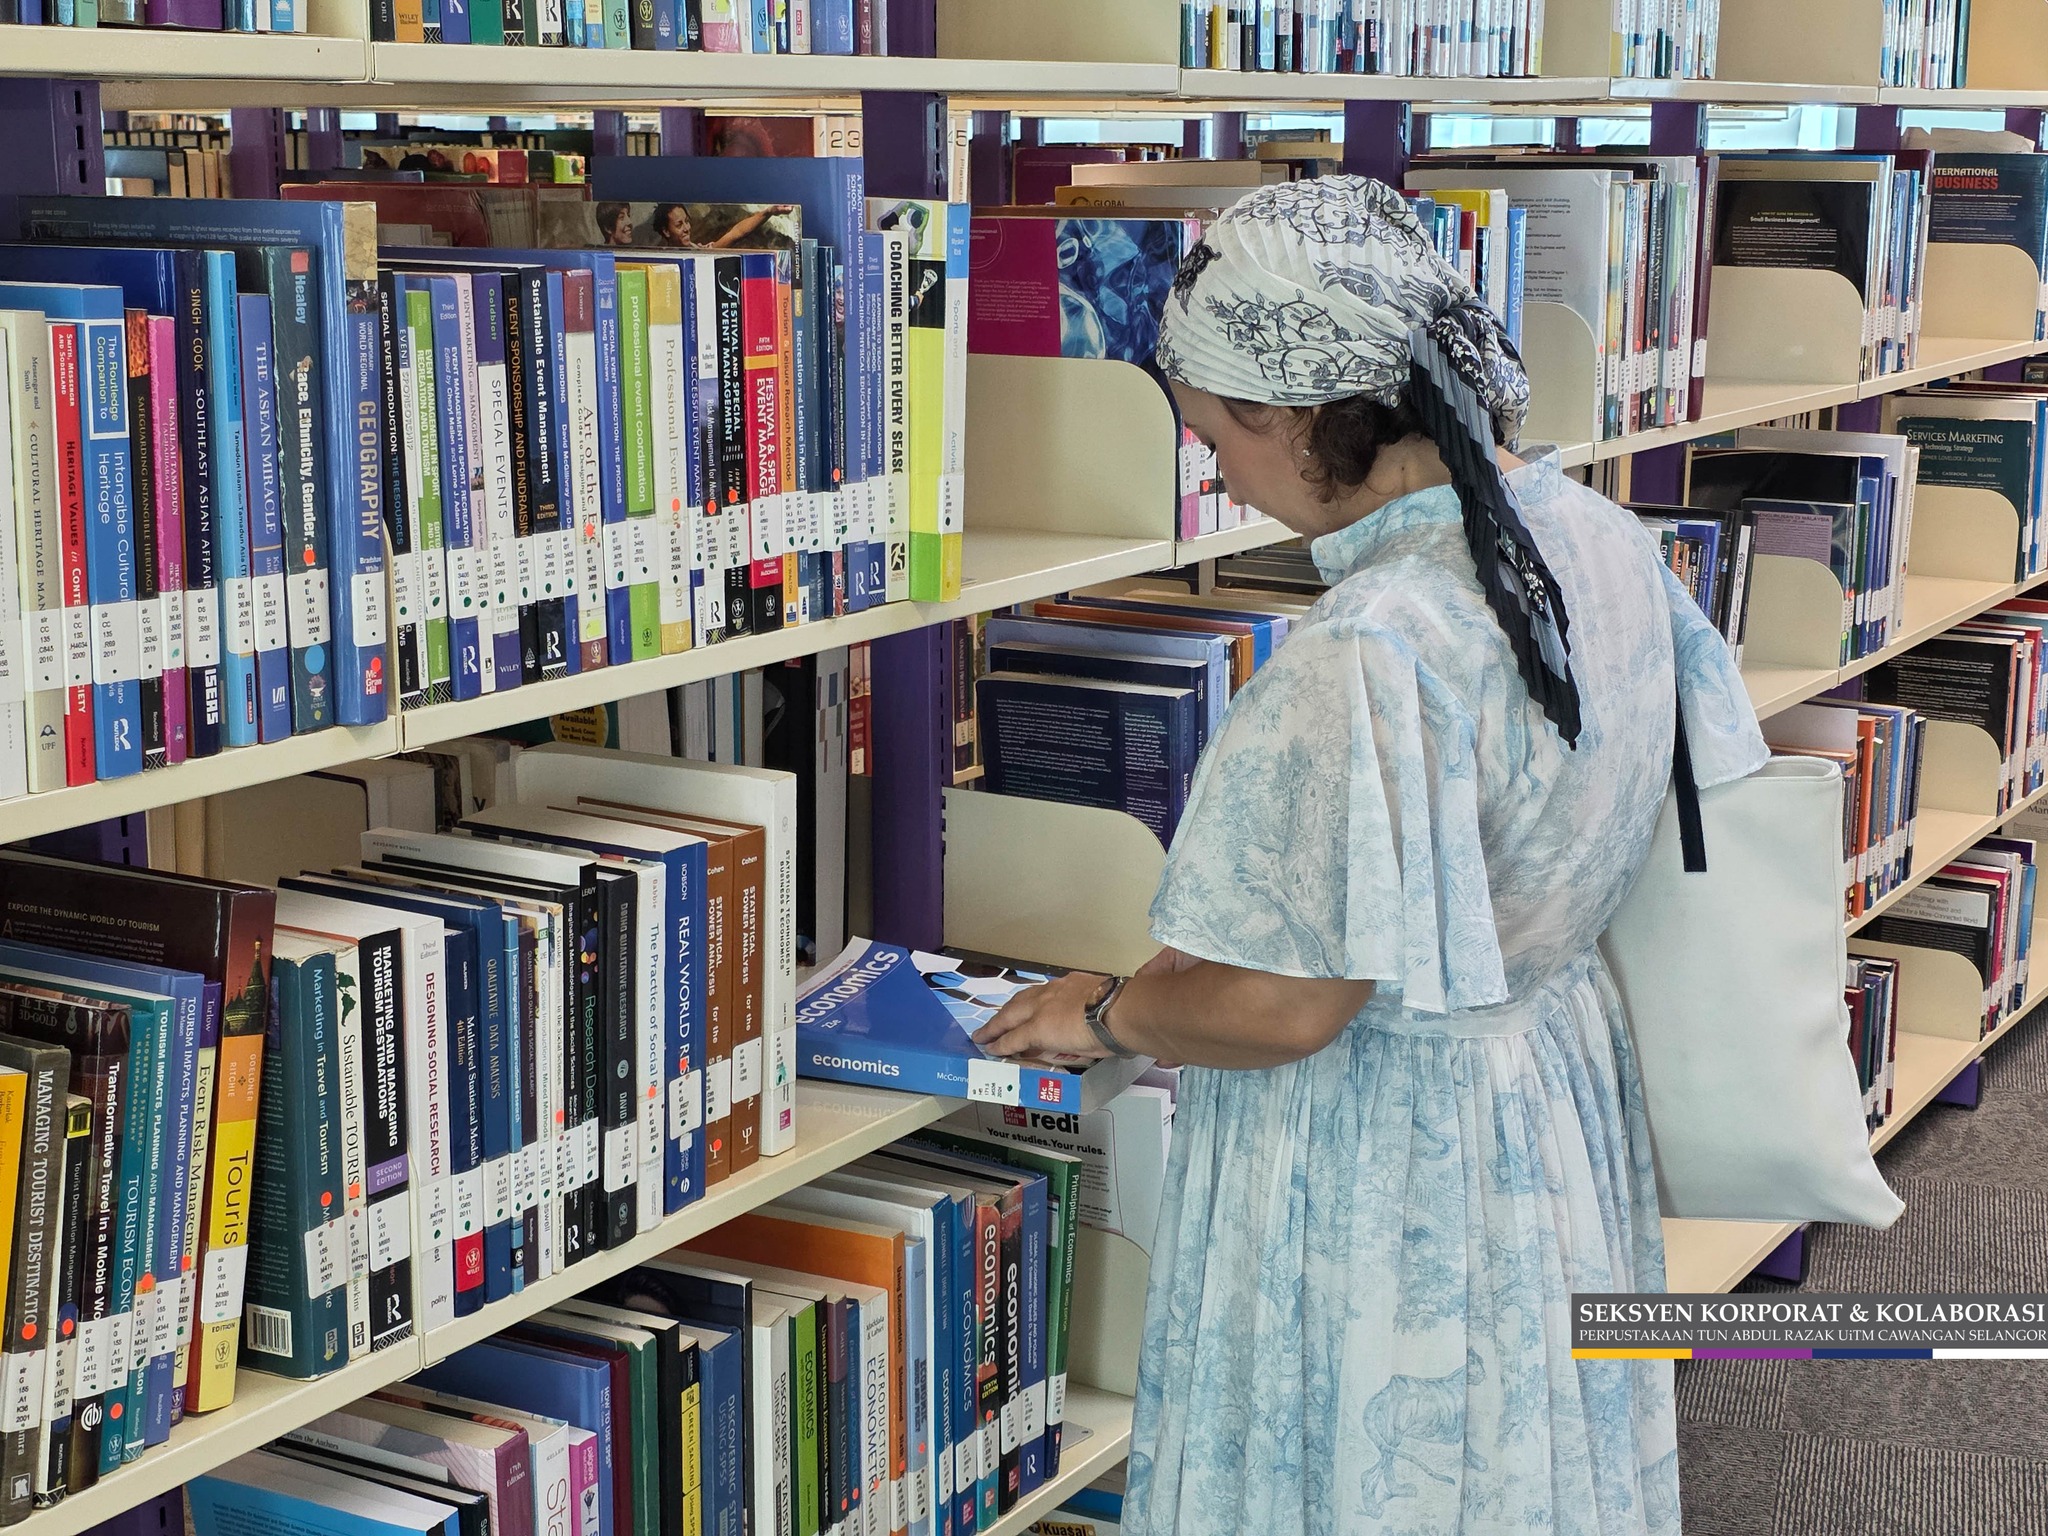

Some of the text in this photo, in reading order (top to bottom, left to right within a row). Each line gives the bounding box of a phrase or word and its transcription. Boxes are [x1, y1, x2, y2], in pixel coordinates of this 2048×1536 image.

[830, 130, 843, 148] 2
[847, 130, 861, 148] 3
[1934, 176, 1999, 190] BUSINESS
[294, 275, 306, 324] Healey
[1509, 216, 1525, 314] TOURISM
[190, 288, 202, 324] SINGH
[380, 292, 392, 382] SPECIAL EVENT
[508, 298, 518, 336] EVENT
[890, 240, 903, 426] COACHING BETTER EVERY
[97, 336, 107, 404] Companion
[108, 336, 119, 422] The Routledge
[193, 337, 204, 372] COOK
[510, 340, 524, 428] SPONSORSHIP
[532, 279, 550, 484] Sustainable Event Management
[722, 302, 732, 442] EVENT MANAGEMENT
[138, 396, 150, 476] SAFEGUARDING
[196, 389, 208, 478] SOUTHEAST
[256, 342, 276, 534] THE ASEAN MIRACLE
[630, 296, 646, 502] professional event coordination
[756, 378, 766, 424] EVENT
[764, 378, 776, 440] FESTIVAL
[1907, 428, 2004, 444] SERVICES MARKETING
[30, 434, 41, 506] CULTURAL
[299, 408, 316, 541] Ethnicity, Gender,
[358, 401, 380, 540] GEOGRAPHY
[492, 380, 508, 518] SPECIAL EVENTS
[515, 432, 524, 458] AND
[585, 446, 598, 505] of the
[1954, 444, 1974, 454] Strategy
[66, 441, 78, 546] HERITAGE VALUES
[98, 453, 110, 524] Heritage
[114, 452, 131, 602] Intangible Cultural
[199, 484, 210, 532] ASIAN
[103, 649, 117, 658] 2017
[500, 663, 520, 673] WILEY
[7, 902, 160, 932] EXPLORE THE DYNAMIC WORLD TOURISM
[486, 958, 500, 1050] QUALITATIVE DATA
[650, 924, 660, 1076] The Practice of Social
[678, 916, 690, 1038] REAL WORLD
[312, 968, 329, 1176] Marketing Travel Tourism
[372, 948, 388, 1120] TOURISM DESTINATIONS
[382, 946, 398, 1147] MARKETING AND MANAGING
[584, 996, 596, 1072] Research
[812, 1052, 900, 1077] economics
[150, 1009, 168, 1170] TOURISM PLANNING
[193, 1064, 210, 1158] Event Risk
[342, 1034, 358, 1120] Sustainable
[425, 972, 440, 1176] DESIGNING SOCIAL RESEARCH
[1040, 1086, 1048, 1100] Mc
[29, 1070, 54, 1221] MANAGING TOURIST
[169, 996, 196, 1271] TOURISM IMPACTS, PLANNING AND MANAGEMENT
[986, 1126, 1106, 1156] Your studies. Your rules.
[1030, 1112, 1080, 1135] redi
[94, 1061, 120, 1294] Transformative Travel in Mobile
[376, 1162, 402, 1176] SECOND
[376, 1172, 402, 1186] EDITION
[122, 1176, 140, 1254] TOURISM
[1064, 1174, 1079, 1284] Principles Economics
[212, 1322, 236, 1334] EDITION
[214, 1300, 228, 1308] 2012
[430, 1294, 448, 1308] polity
[983, 1224, 1000, 1366] economics
[962, 1288, 972, 1412] ECONOMICS
[982, 1378, 998, 1391] TENTH
[804, 1351, 814, 1440] ECONOMICS
[982, 1385, 998, 1400] EDITION
[316, 1438, 339, 1450] Authors
[506, 1470, 526, 1488] Edition
[510, 1462, 522, 1474] 17th
[718, 1402, 728, 1486] USING SPSS
[727, 1394, 738, 1495] DISCOVERING
